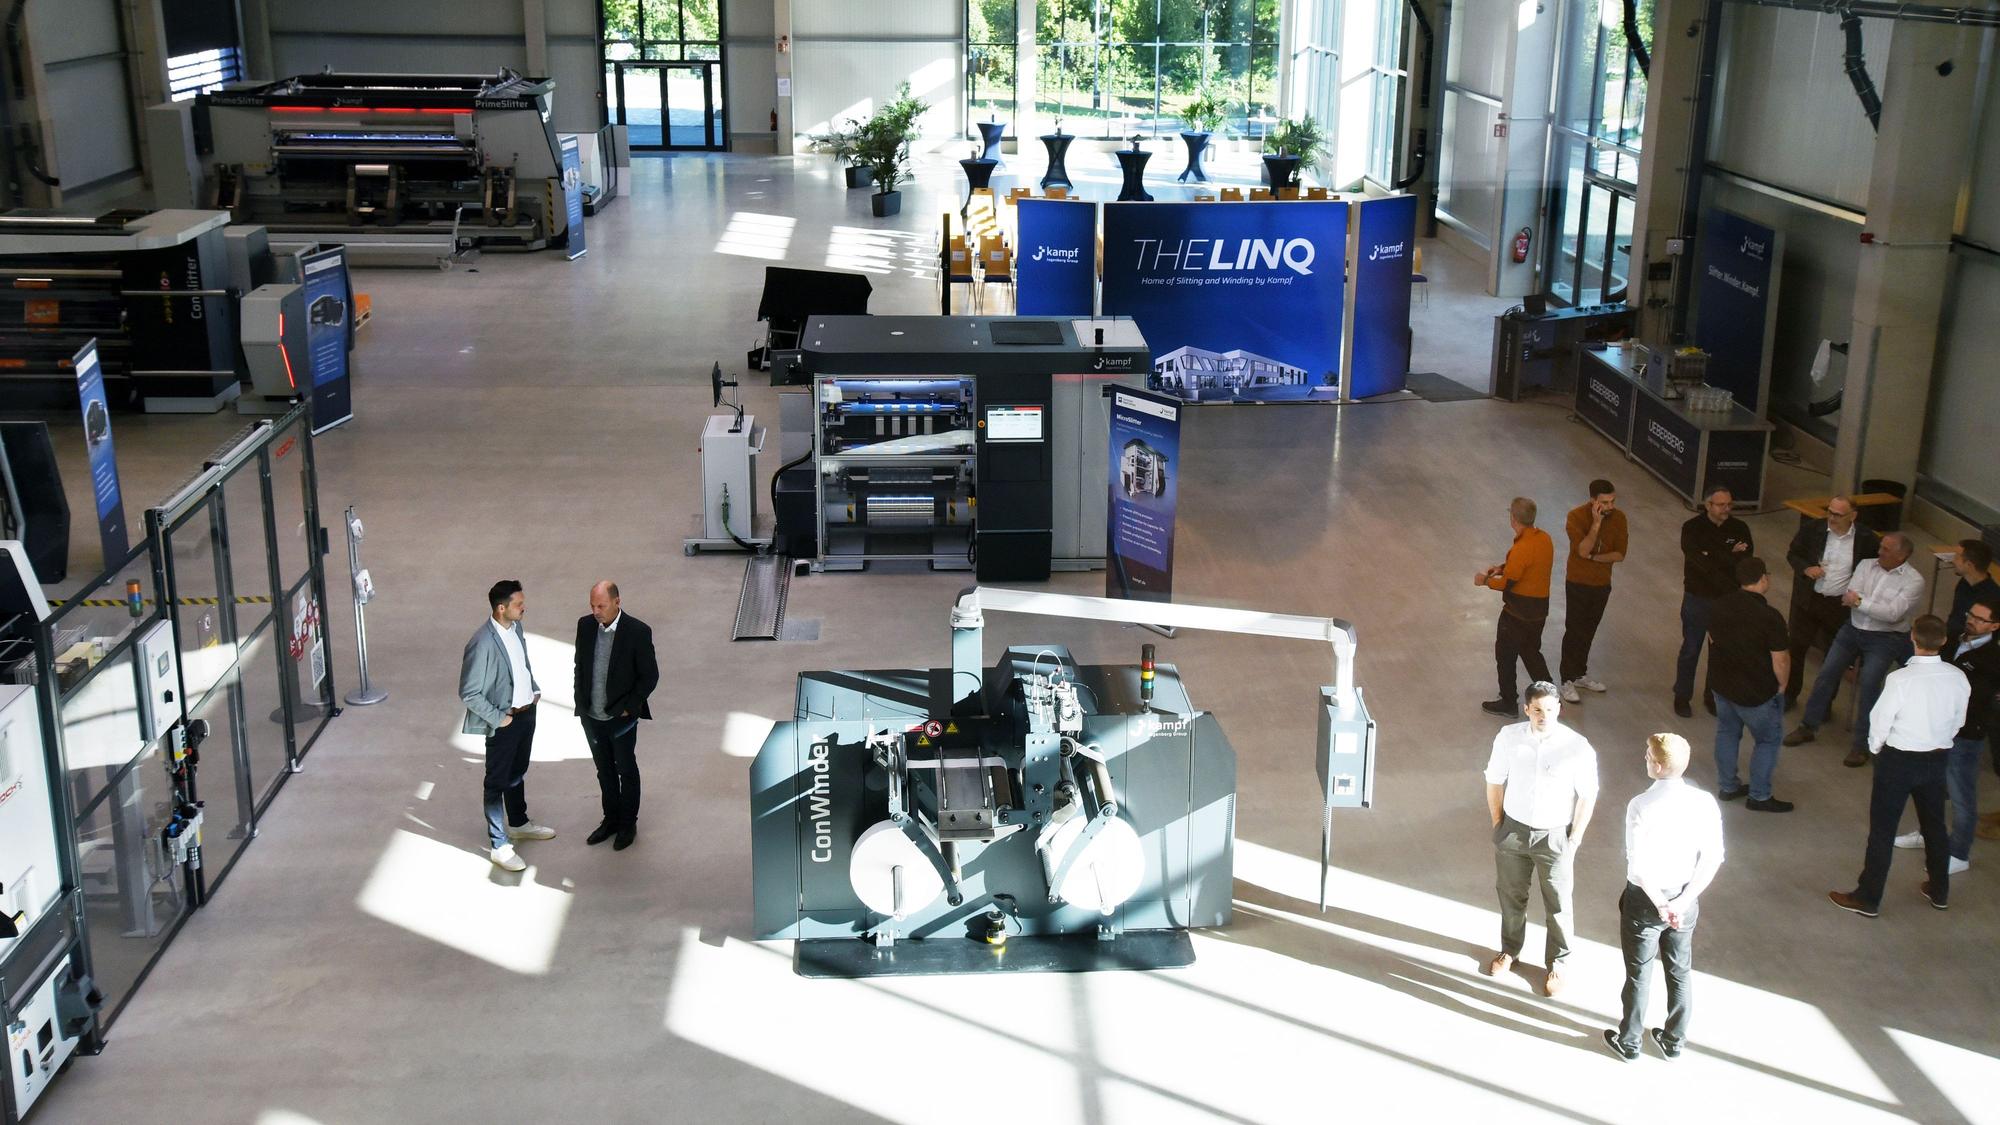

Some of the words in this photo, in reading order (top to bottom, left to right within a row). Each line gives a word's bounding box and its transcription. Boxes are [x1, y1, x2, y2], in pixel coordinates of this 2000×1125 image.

[475, 100, 529, 108] PrimeSlitter
[1046, 246, 1079, 259] kampf
[1380, 241, 1403, 254] kampf
[186, 256, 202, 319] Conlitter
[1141, 277, 1165, 285] Home
[1166, 277, 1175, 286] of
[1176, 277, 1203, 286] Slitting
[1204, 276, 1220, 285] and
[1222, 277, 1254, 286] Winding
[1255, 277, 1265, 286] by
[1267, 276, 1294, 286] Kampf
[1105, 357, 1131, 367] kampf
[808, 733, 832, 863] ConWinder
